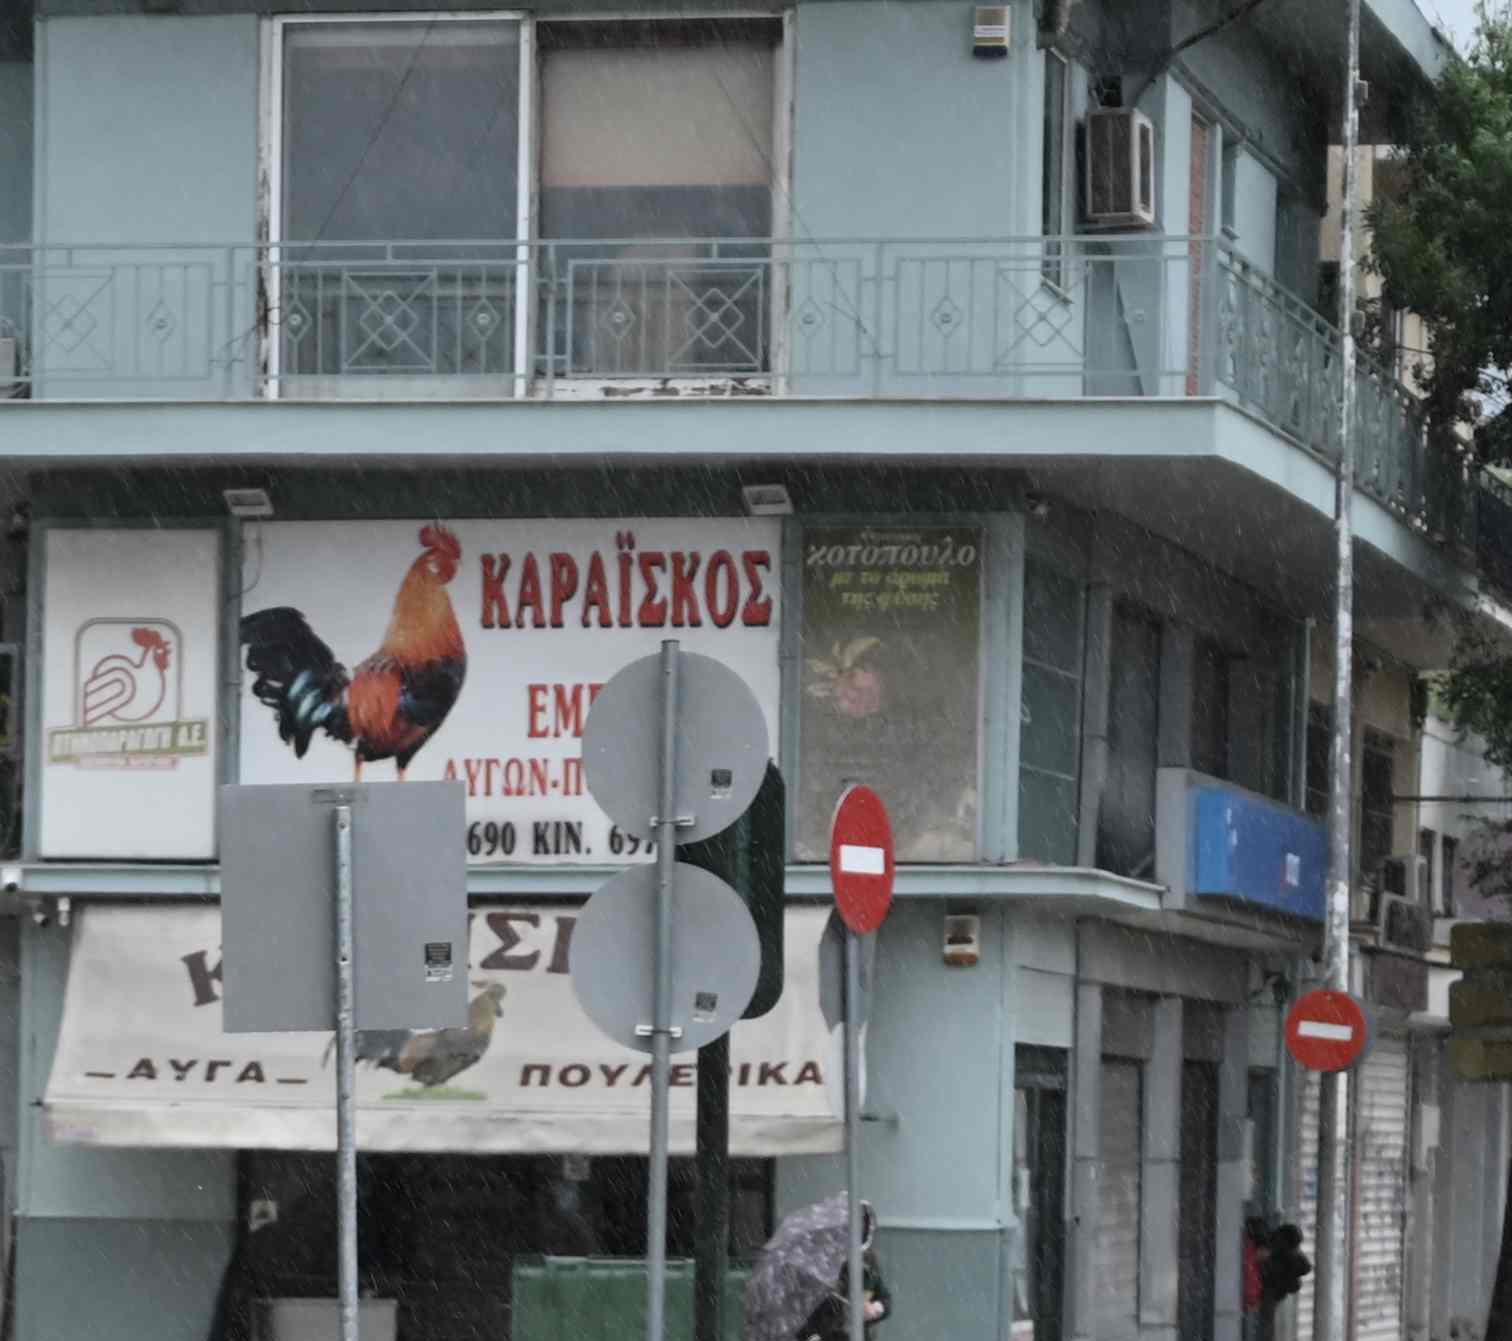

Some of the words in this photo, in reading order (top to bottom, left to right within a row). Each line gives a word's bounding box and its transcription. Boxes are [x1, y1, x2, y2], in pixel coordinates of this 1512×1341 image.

[480, 530, 773, 630] ΚΑΡΑΪΣΚΟΣ
[125, 1057, 267, 1084] ΑΥΓΑ
[519, 1061, 825, 1088] ΠΟΥΛΕΙΚΑ
